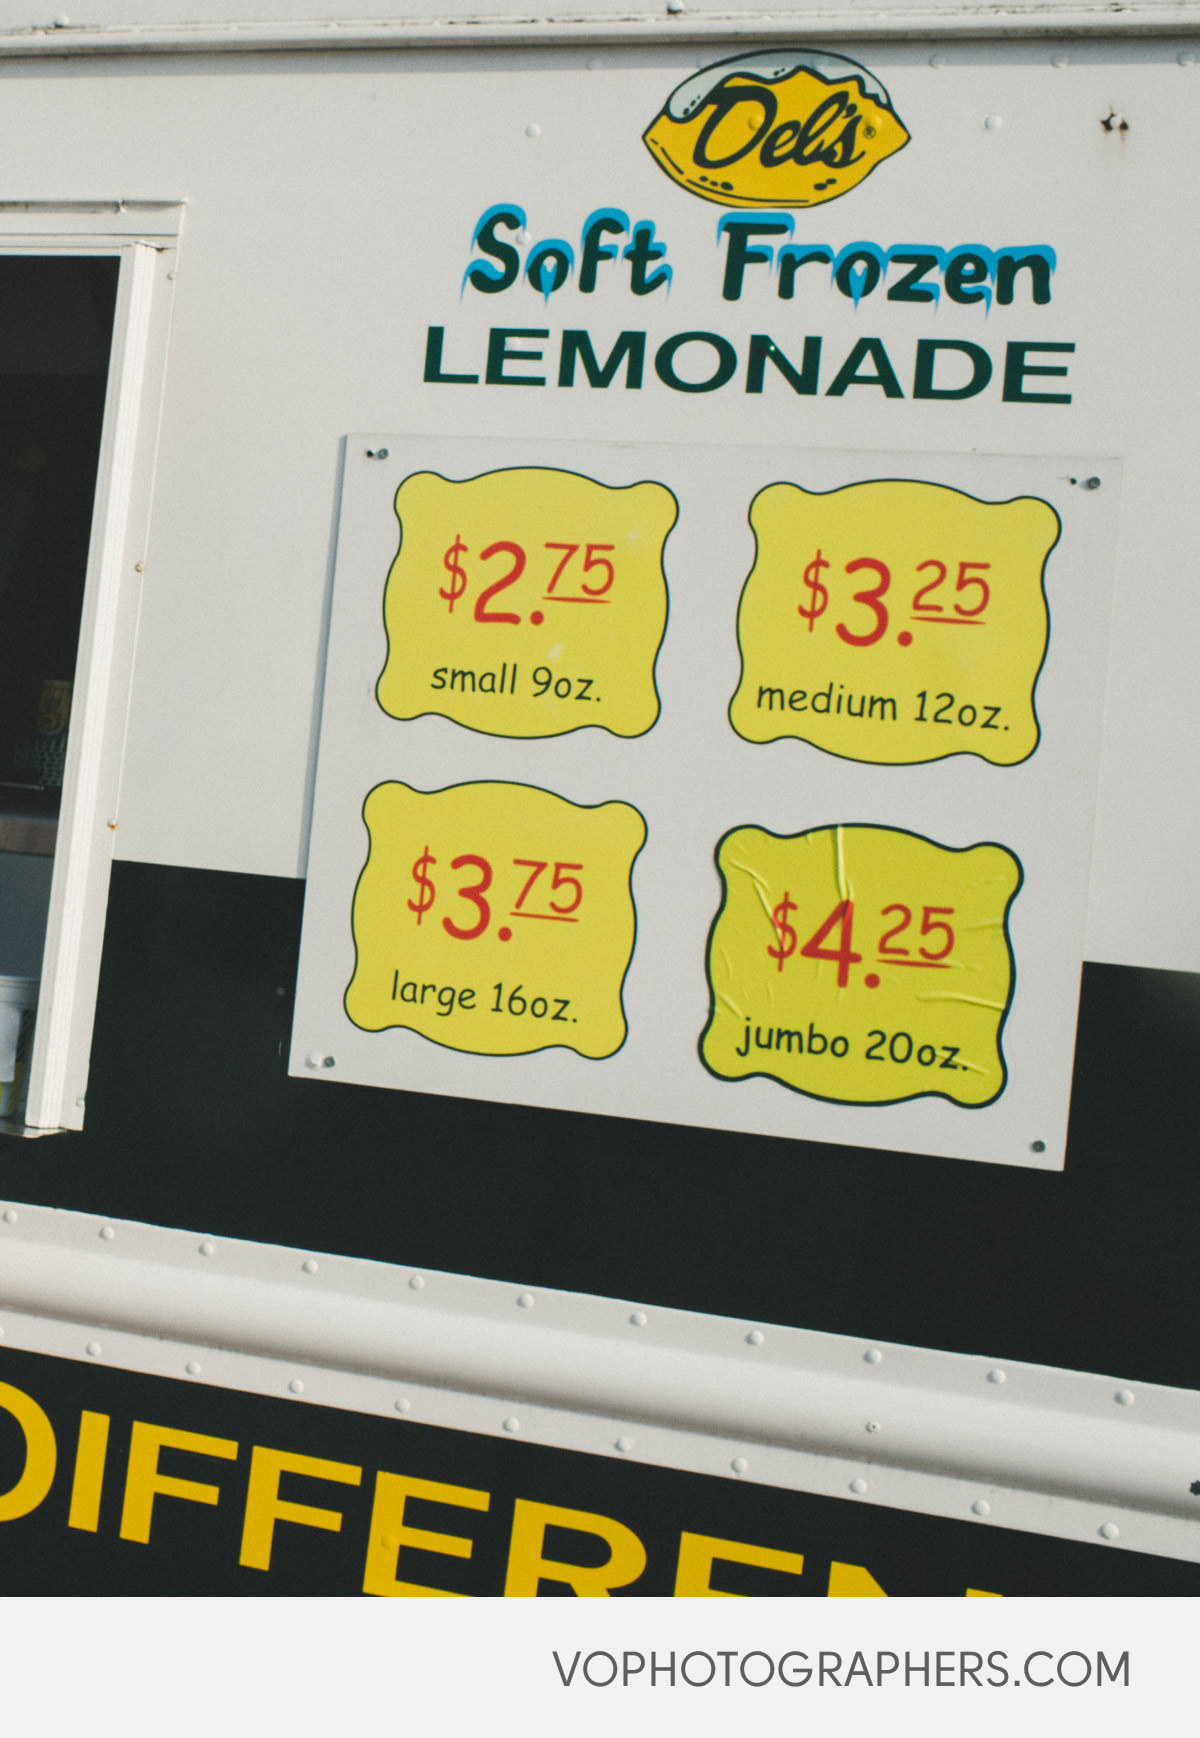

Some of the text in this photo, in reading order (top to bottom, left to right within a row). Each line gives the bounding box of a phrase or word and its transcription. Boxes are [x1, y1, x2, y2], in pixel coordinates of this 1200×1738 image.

[461, 203, 1057, 320] Soft Frozen
[423, 326, 1076, 404] LEMONADE
[439, 534, 615, 626] $2.75
[798, 550, 991, 647] $3.25
[430, 663, 602, 703] small 9oz.
[757, 682, 1011, 733] medium 12oz.
[407, 846, 584, 942] $3.75
[767, 891, 956, 989] $4.25
[391, 970, 579, 1024] large 16oz.
[736, 1017, 970, 1073] jumbo 20oz.
